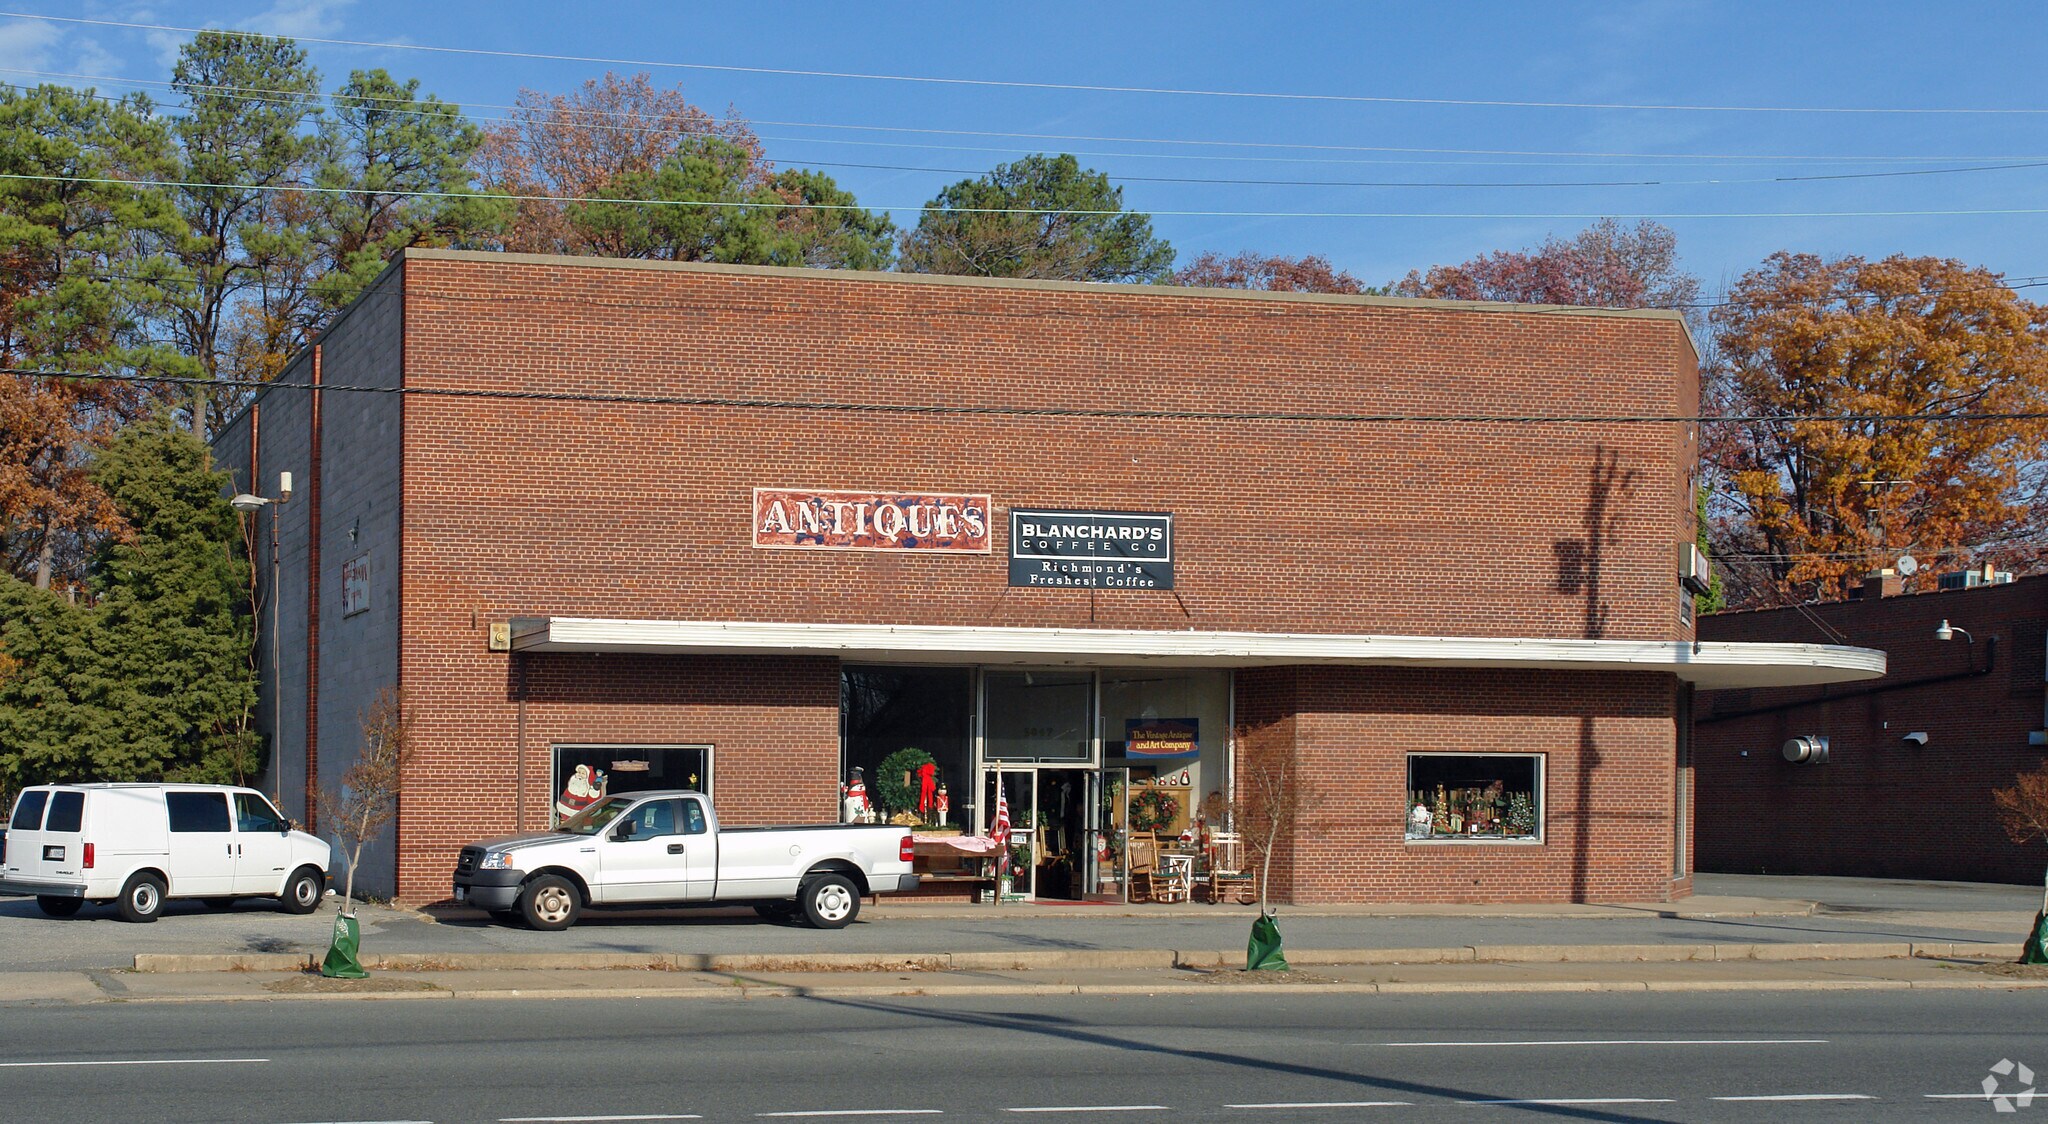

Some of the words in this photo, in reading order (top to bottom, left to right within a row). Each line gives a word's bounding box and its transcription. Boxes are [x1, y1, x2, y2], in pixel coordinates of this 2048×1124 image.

[759, 500, 986, 543] ANTIQUES
[1022, 524, 1162, 540] BLANCHARD'S
[1022, 540, 1111, 551] COFFEE
[1130, 543, 1156, 552] CO
[1042, 561, 1142, 574] Richmond's
[1029, 574, 1097, 586] Freshest
[1105, 576, 1154, 587] Coffee
[1132, 730, 1145, 739] The
[1145, 730, 1168, 740] Vintage
[1136, 741, 1149, 749] and
[1150, 741, 1160, 749] Art
[1160, 741, 1191, 751] Company
